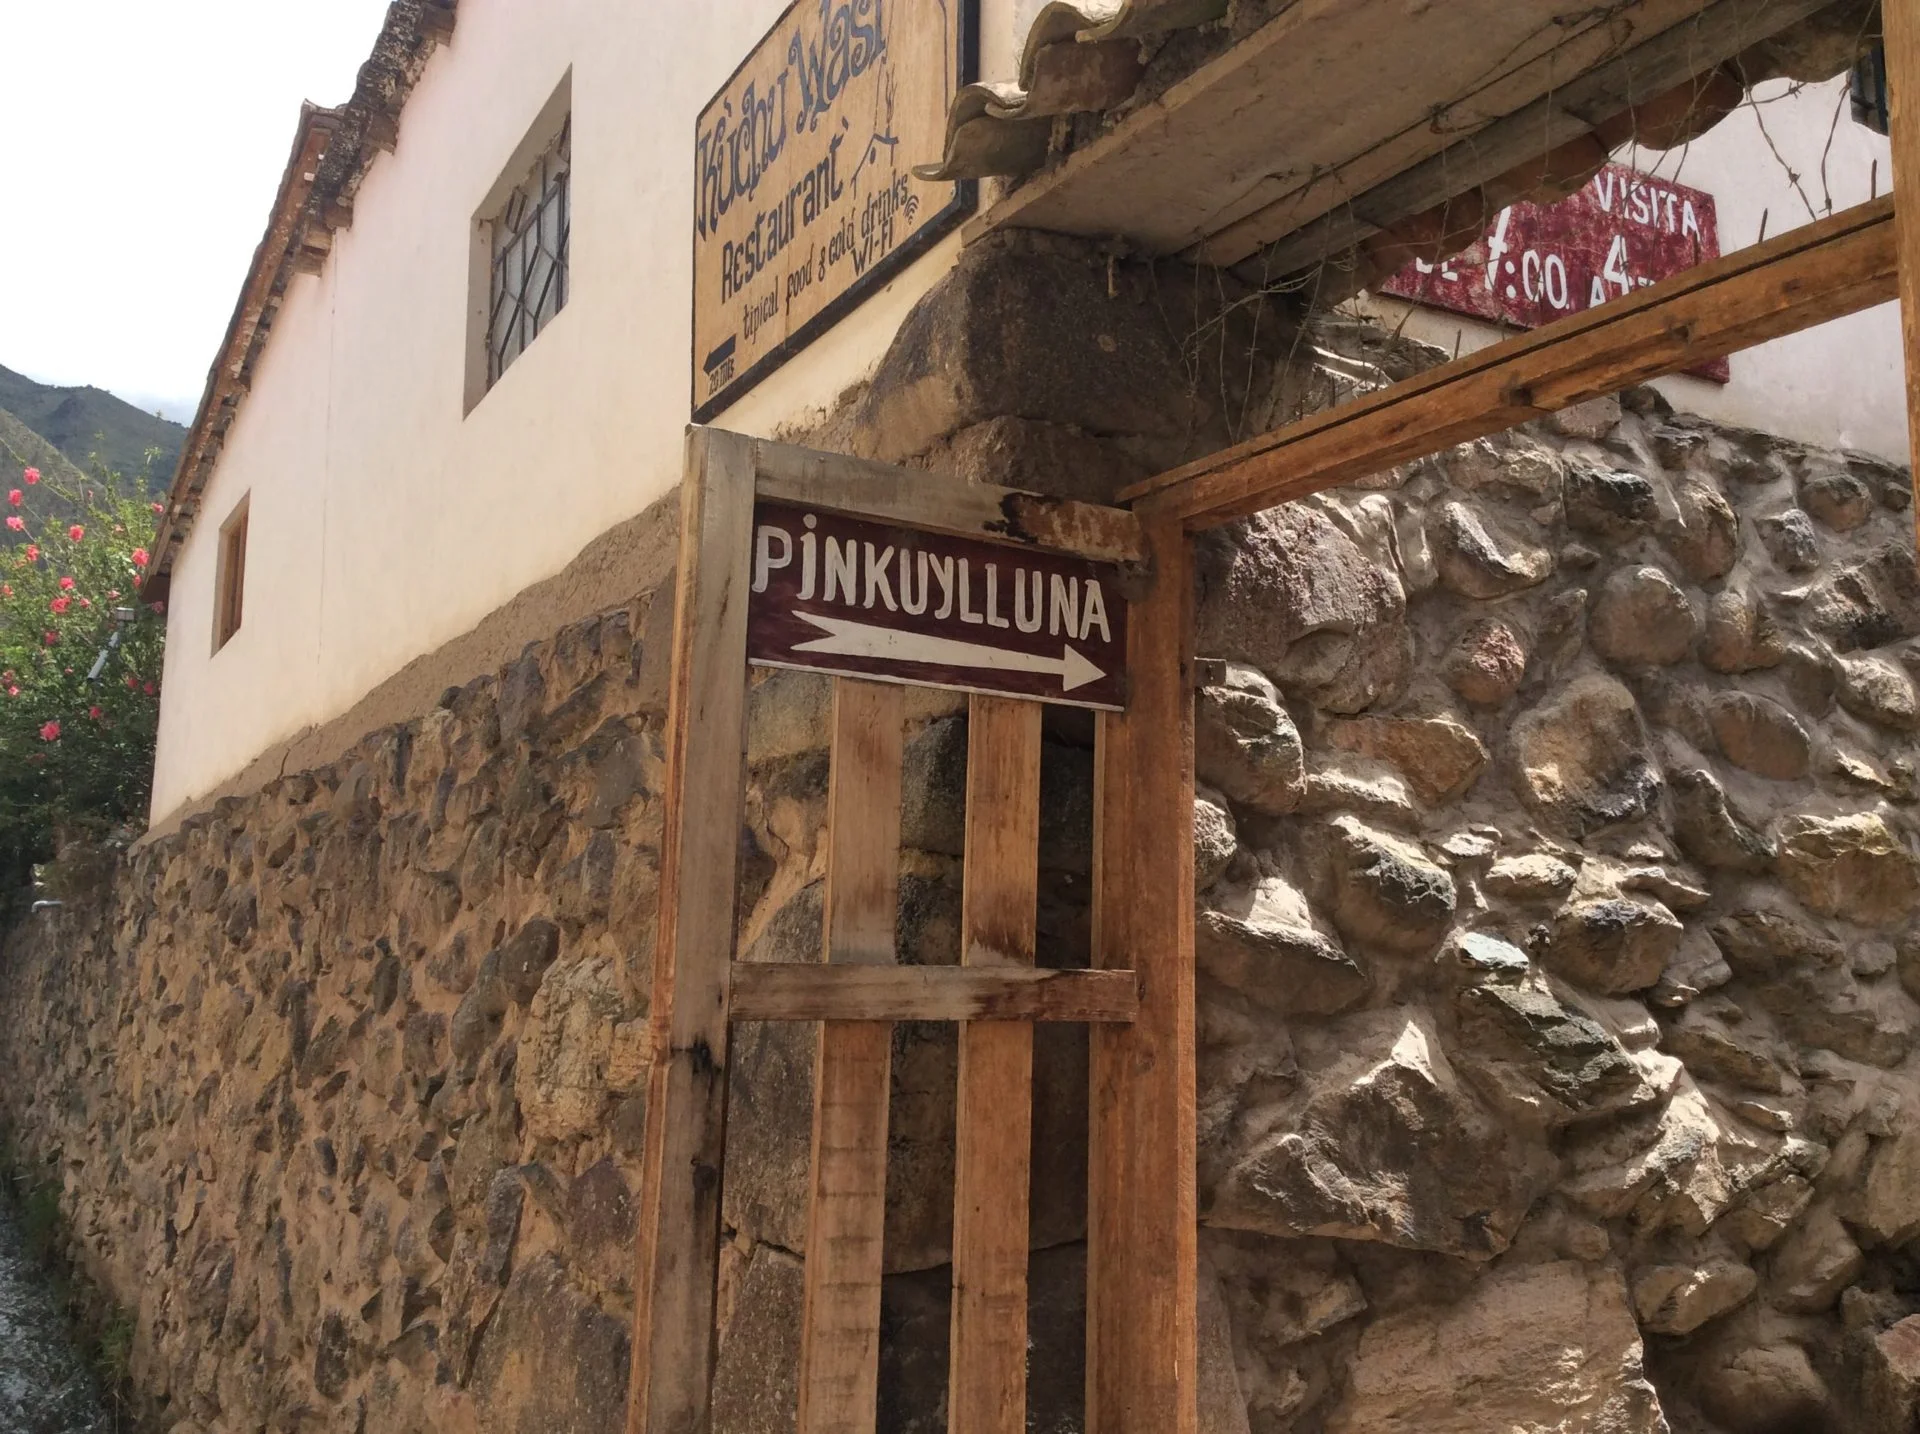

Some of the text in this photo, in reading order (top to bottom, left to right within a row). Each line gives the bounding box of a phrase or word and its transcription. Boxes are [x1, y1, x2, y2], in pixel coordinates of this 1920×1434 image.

[721, 132, 845, 304] Restaurant
[742, 275, 779, 345] tipical
[785, 242, 815, 317] food
[828, 206, 856, 267] cold
[861, 168, 909, 240] drinks
[1593, 171, 1701, 243] VISITA
